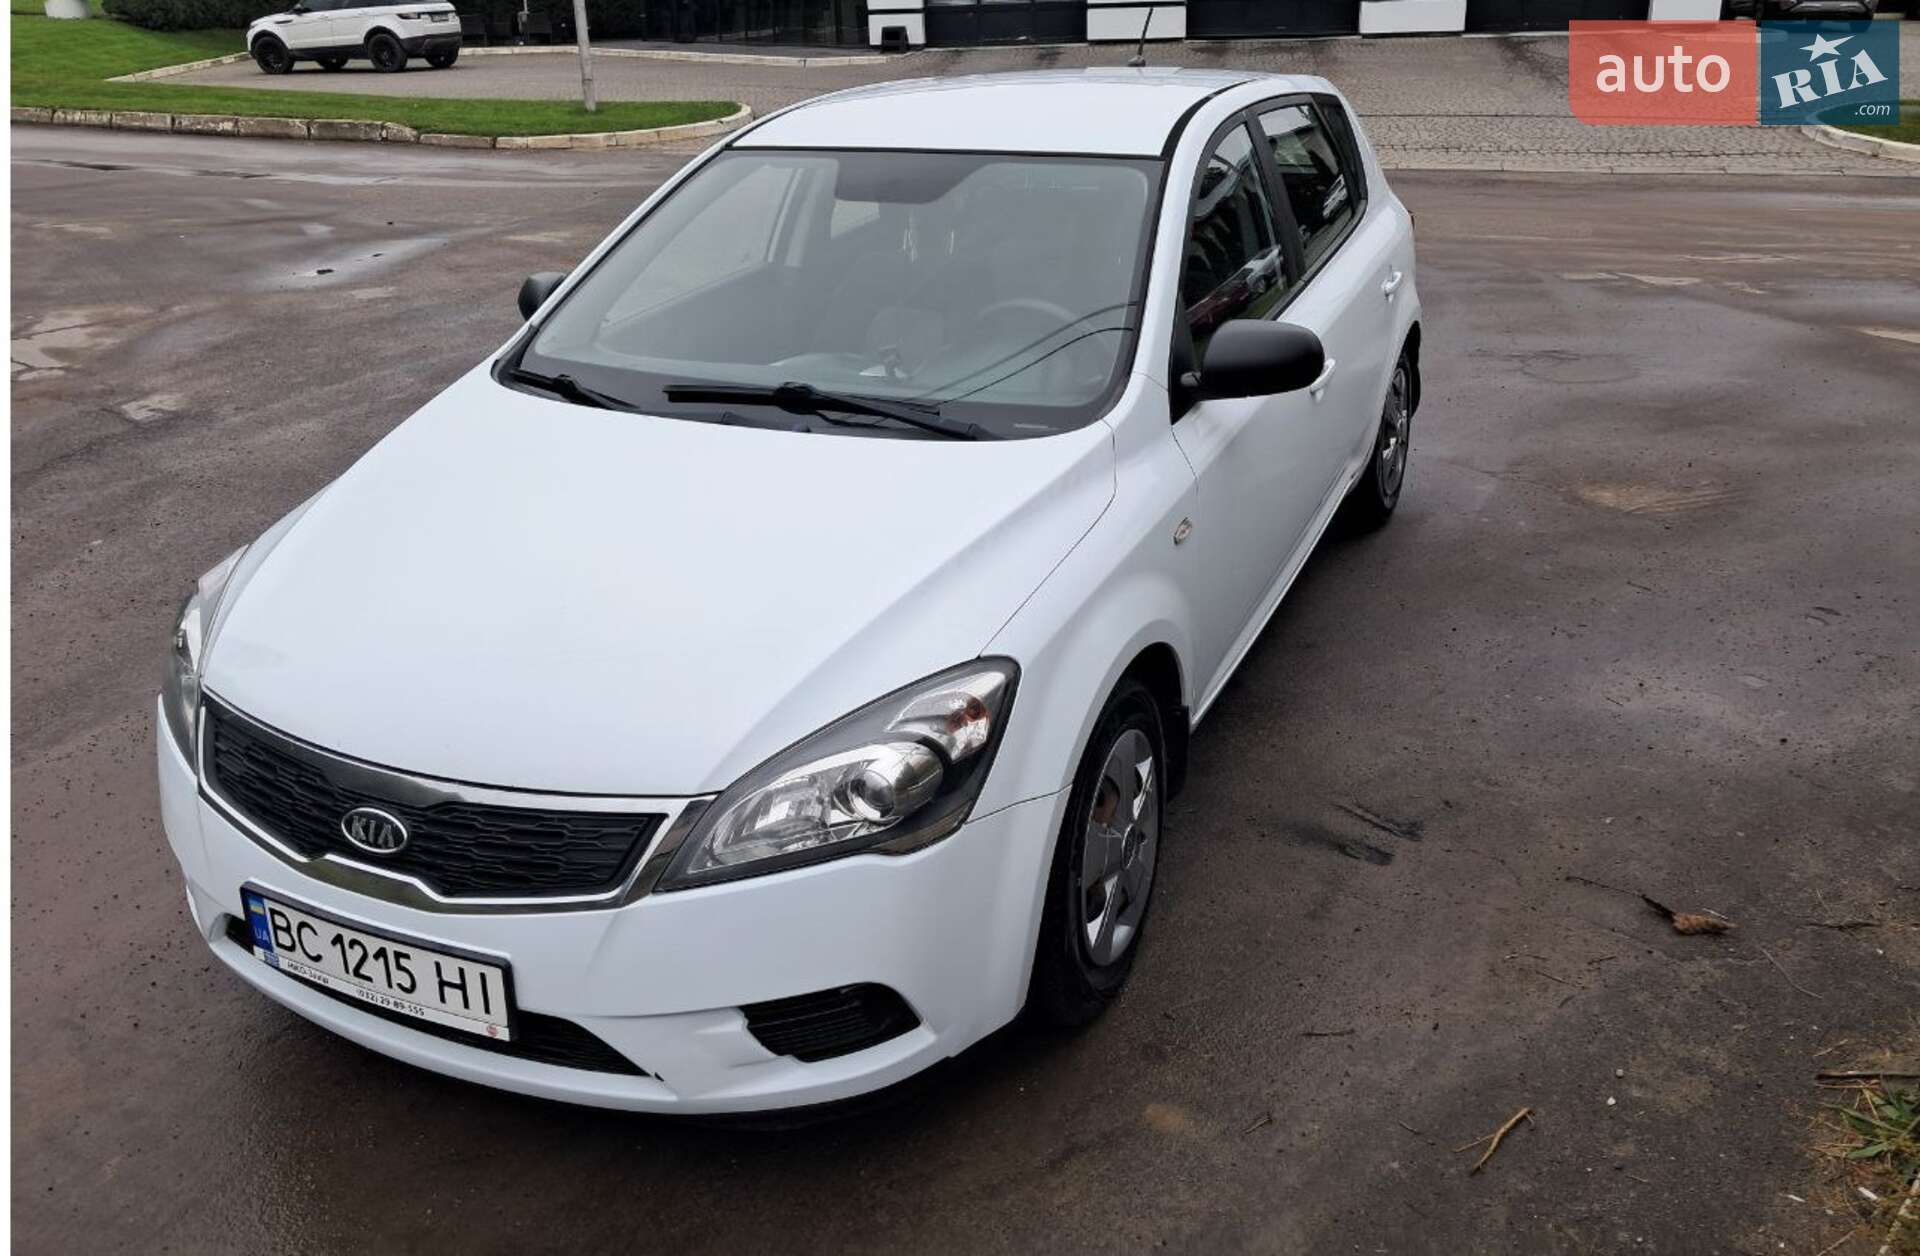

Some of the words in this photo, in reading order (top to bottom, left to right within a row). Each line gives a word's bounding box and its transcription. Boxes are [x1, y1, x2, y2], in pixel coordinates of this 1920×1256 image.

[351, 815, 395, 848] KIA
[254, 928, 271, 945] UA
[268, 907, 322, 962] BC
[331, 933, 416, 994] 1215
[435, 961, 491, 1015] HI
